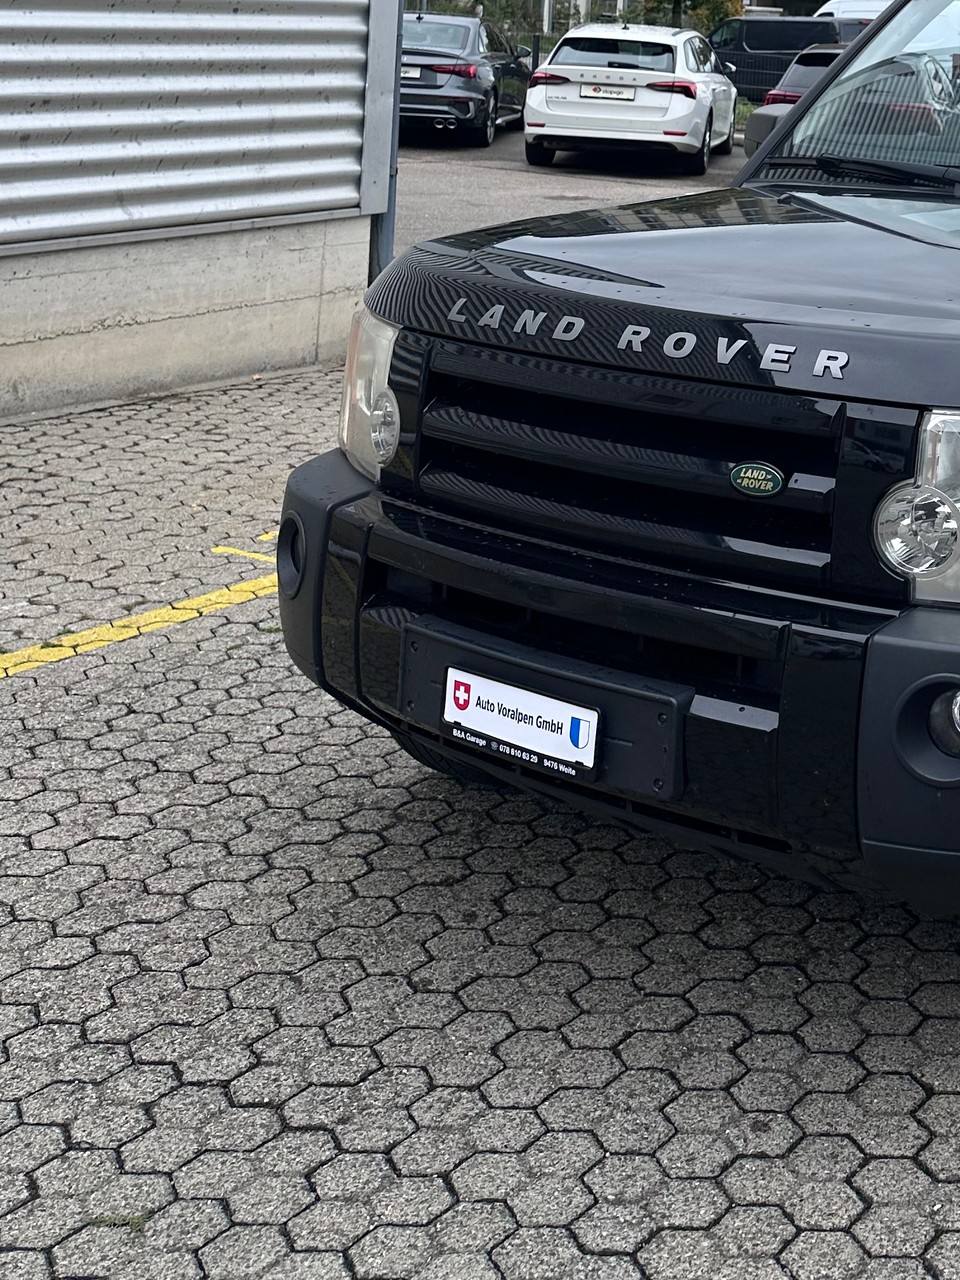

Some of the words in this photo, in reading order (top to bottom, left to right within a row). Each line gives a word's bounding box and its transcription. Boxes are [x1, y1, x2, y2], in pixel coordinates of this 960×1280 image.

[447, 298, 585, 341] LAND
[617, 325, 850, 379] ROVER
[740, 468, 766, 480] LAND
[741, 478, 774, 491] ROVER
[475, 695, 495, 713] Auto
[497, 701, 534, 726] Voralpen
[536, 714, 564, 735] GmbH
[452, 728, 465, 739] B&A
[466, 733, 487, 747] Garage
[499, 744, 510, 754] 078
[543, 758, 558, 770] 9476
[558, 763, 576, 776] Weite
